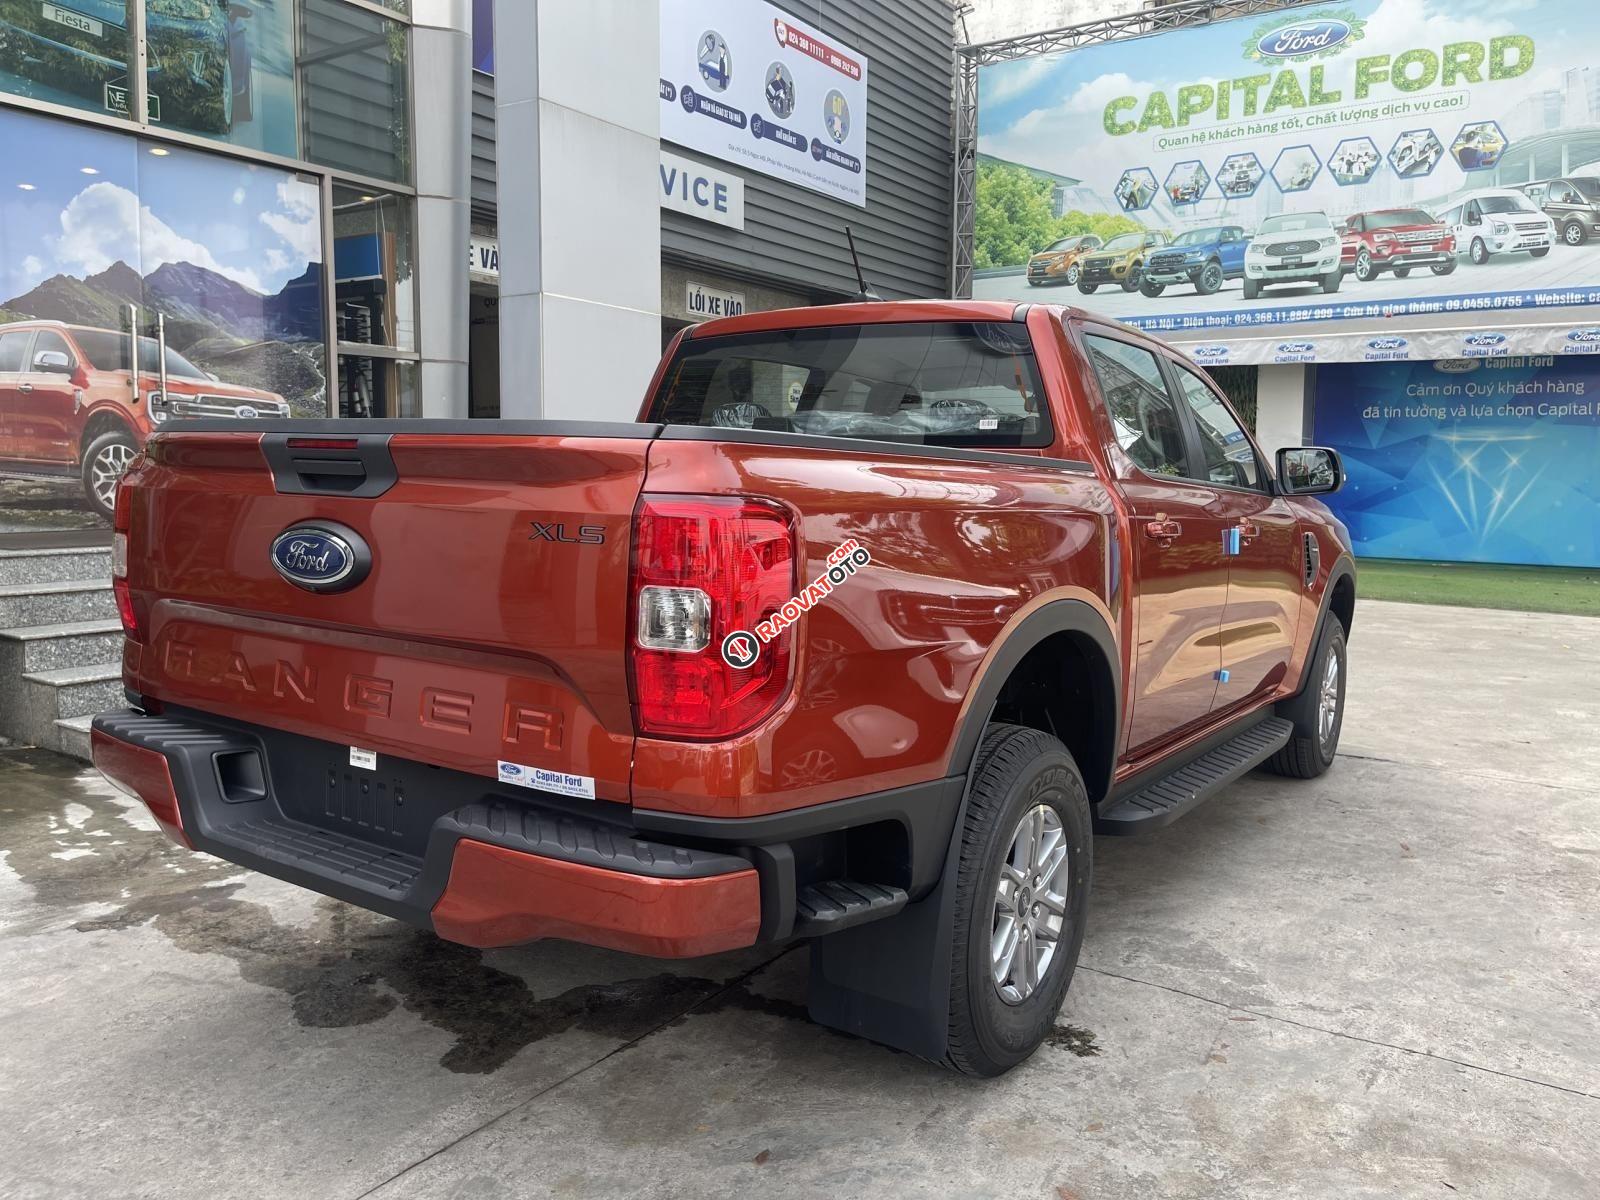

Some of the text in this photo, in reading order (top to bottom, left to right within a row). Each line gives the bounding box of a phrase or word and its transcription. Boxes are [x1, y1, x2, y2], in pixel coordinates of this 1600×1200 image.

[54, 9, 91, 31] Fiesta
[1273, 26, 1333, 53] Ford
[1103, 34, 1535, 137] CAPITAL FORD
[1158, 95, 1464, 150] Quan hệ khách hàng tốt, Chất lượng dịch vụ cao!
[660, 163, 727, 213] VICE
[689, 286, 742, 317] LỐI XE VÀO
[1145, 318, 1157, 329] Hà
[1159, 317, 1175, 330] Nội
[1206, 314, 1233, 328] thoại:
[1343, 305, 1364, 317] Cứu
[1366, 302, 1379, 317] hộ
[1408, 301, 1443, 313] thông:
[1446, 295, 1522, 310] 09.0455.0755
[1535, 292, 1585, 305] Website:
[1283, 343, 1307, 353] Ford
[1373, 337, 1399, 349] Ford
[1471, 333, 1498, 346] Ford
[1274, 353, 1315, 363] Capital Ford
[1365, 351, 1409, 361] Capital Ford
[1462, 347, 1508, 357] Capital Ford
[1564, 345, 1593, 354] Capital
[1485, 355, 1554, 369] Capital Ford
[1406, 380, 1585, 399] Cảm ơn Quý khách hàng
[1362, 406, 1380, 418] đã
[1383, 406, 1401, 418] tin
[1404, 404, 1447, 420] tưởng
[1449, 404, 1467, 417] và
[1470, 404, 1493, 418] lựa
[1497, 404, 1534, 419] chọn
[1537, 402, 1592, 418] Capital
[528, 521, 607, 545] XLS
[286, 541, 330, 572] Ford
[163, 639, 564, 751] RANGER
[535, 769, 562, 784] Capital
[564, 775, 582, 787] Ford
